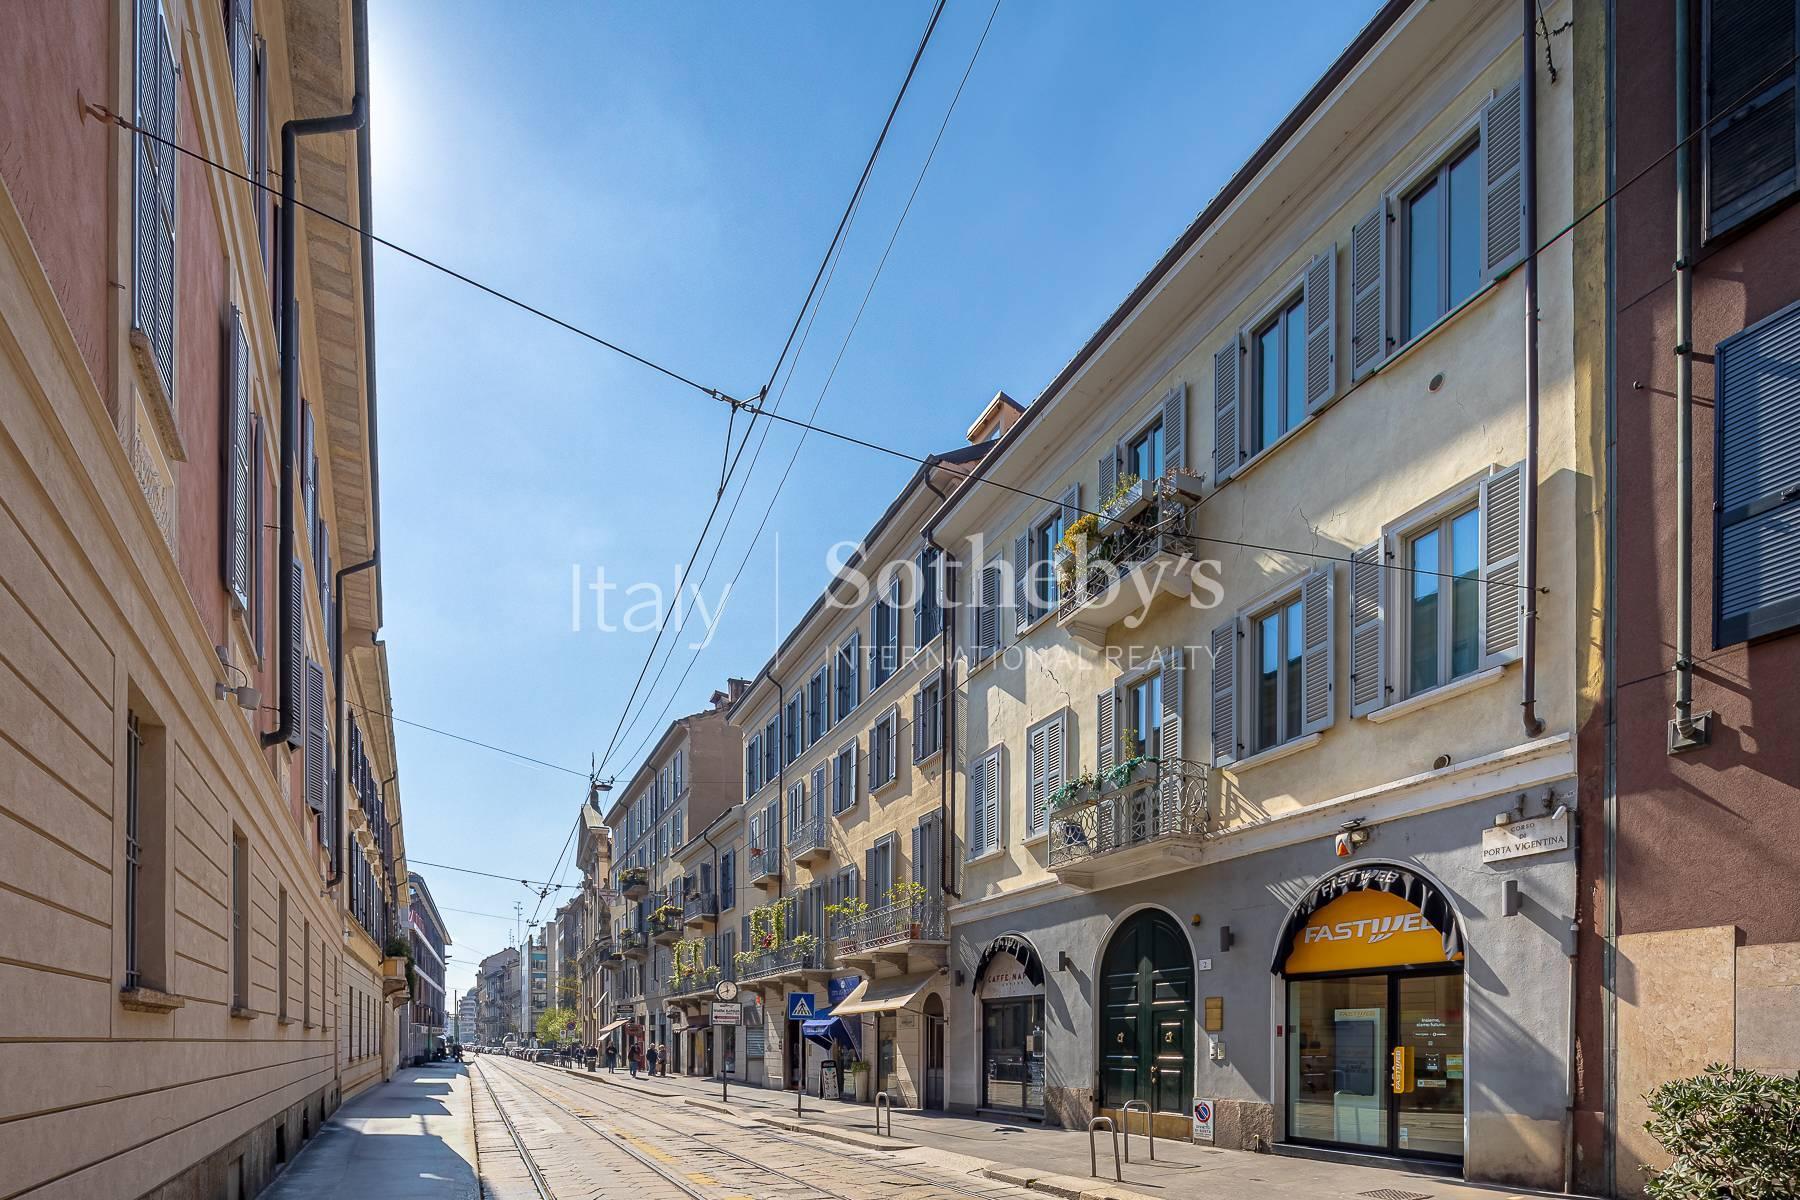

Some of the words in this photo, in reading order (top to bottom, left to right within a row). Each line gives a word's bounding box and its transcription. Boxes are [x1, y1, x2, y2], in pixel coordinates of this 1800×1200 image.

[1511, 823, 1535, 833] CORSO
[1484, 847, 1512, 857] PORTA
[1515, 836, 1565, 851] VIGENTINA
